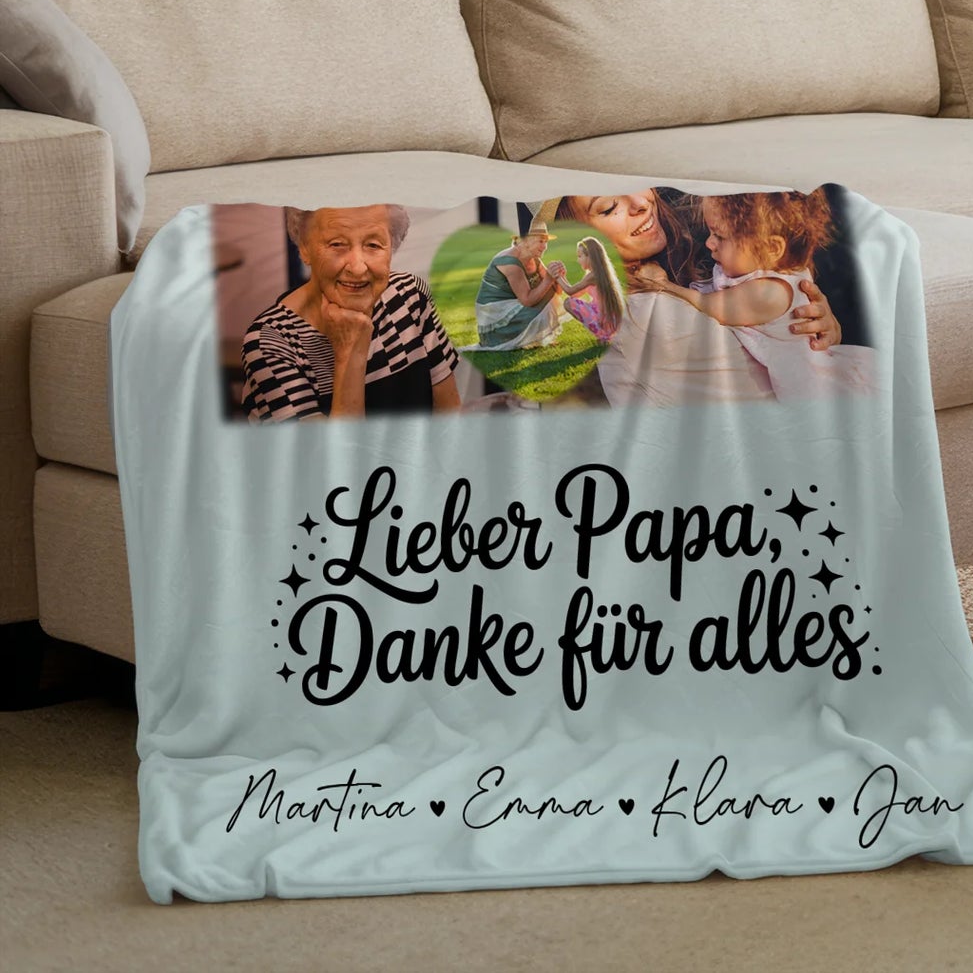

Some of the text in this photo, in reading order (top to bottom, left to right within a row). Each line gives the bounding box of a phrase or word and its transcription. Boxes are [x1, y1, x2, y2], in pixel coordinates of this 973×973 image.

[322, 463, 782, 605] Lieber Papa,
[287, 584, 545, 707] Danke
[557, 585, 675, 712] für
[225, 755, 964, 849] Martina Emma Klara Jan
